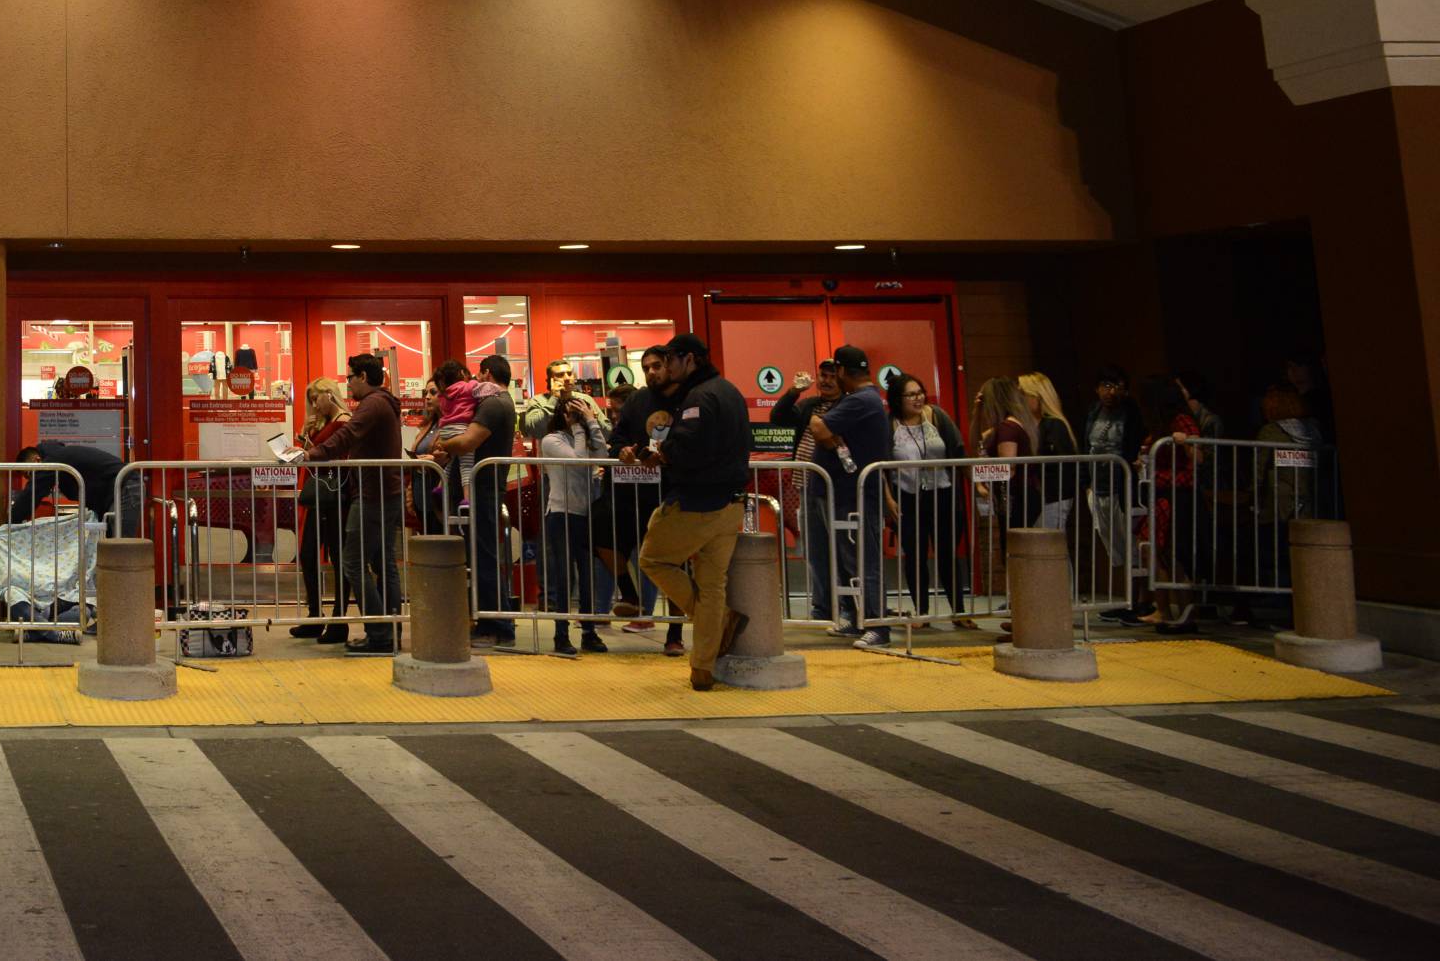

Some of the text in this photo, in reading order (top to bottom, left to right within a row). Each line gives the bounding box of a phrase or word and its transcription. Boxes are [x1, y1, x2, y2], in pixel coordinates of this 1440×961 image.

[751, 428, 795, 437] LINE STARTS
[772, 435, 793, 443] DOOR
[254, 467, 297, 476] NATIONAL
[613, 466, 659, 475] NATIONAL
[975, 464, 1010, 473] NATIONAL
